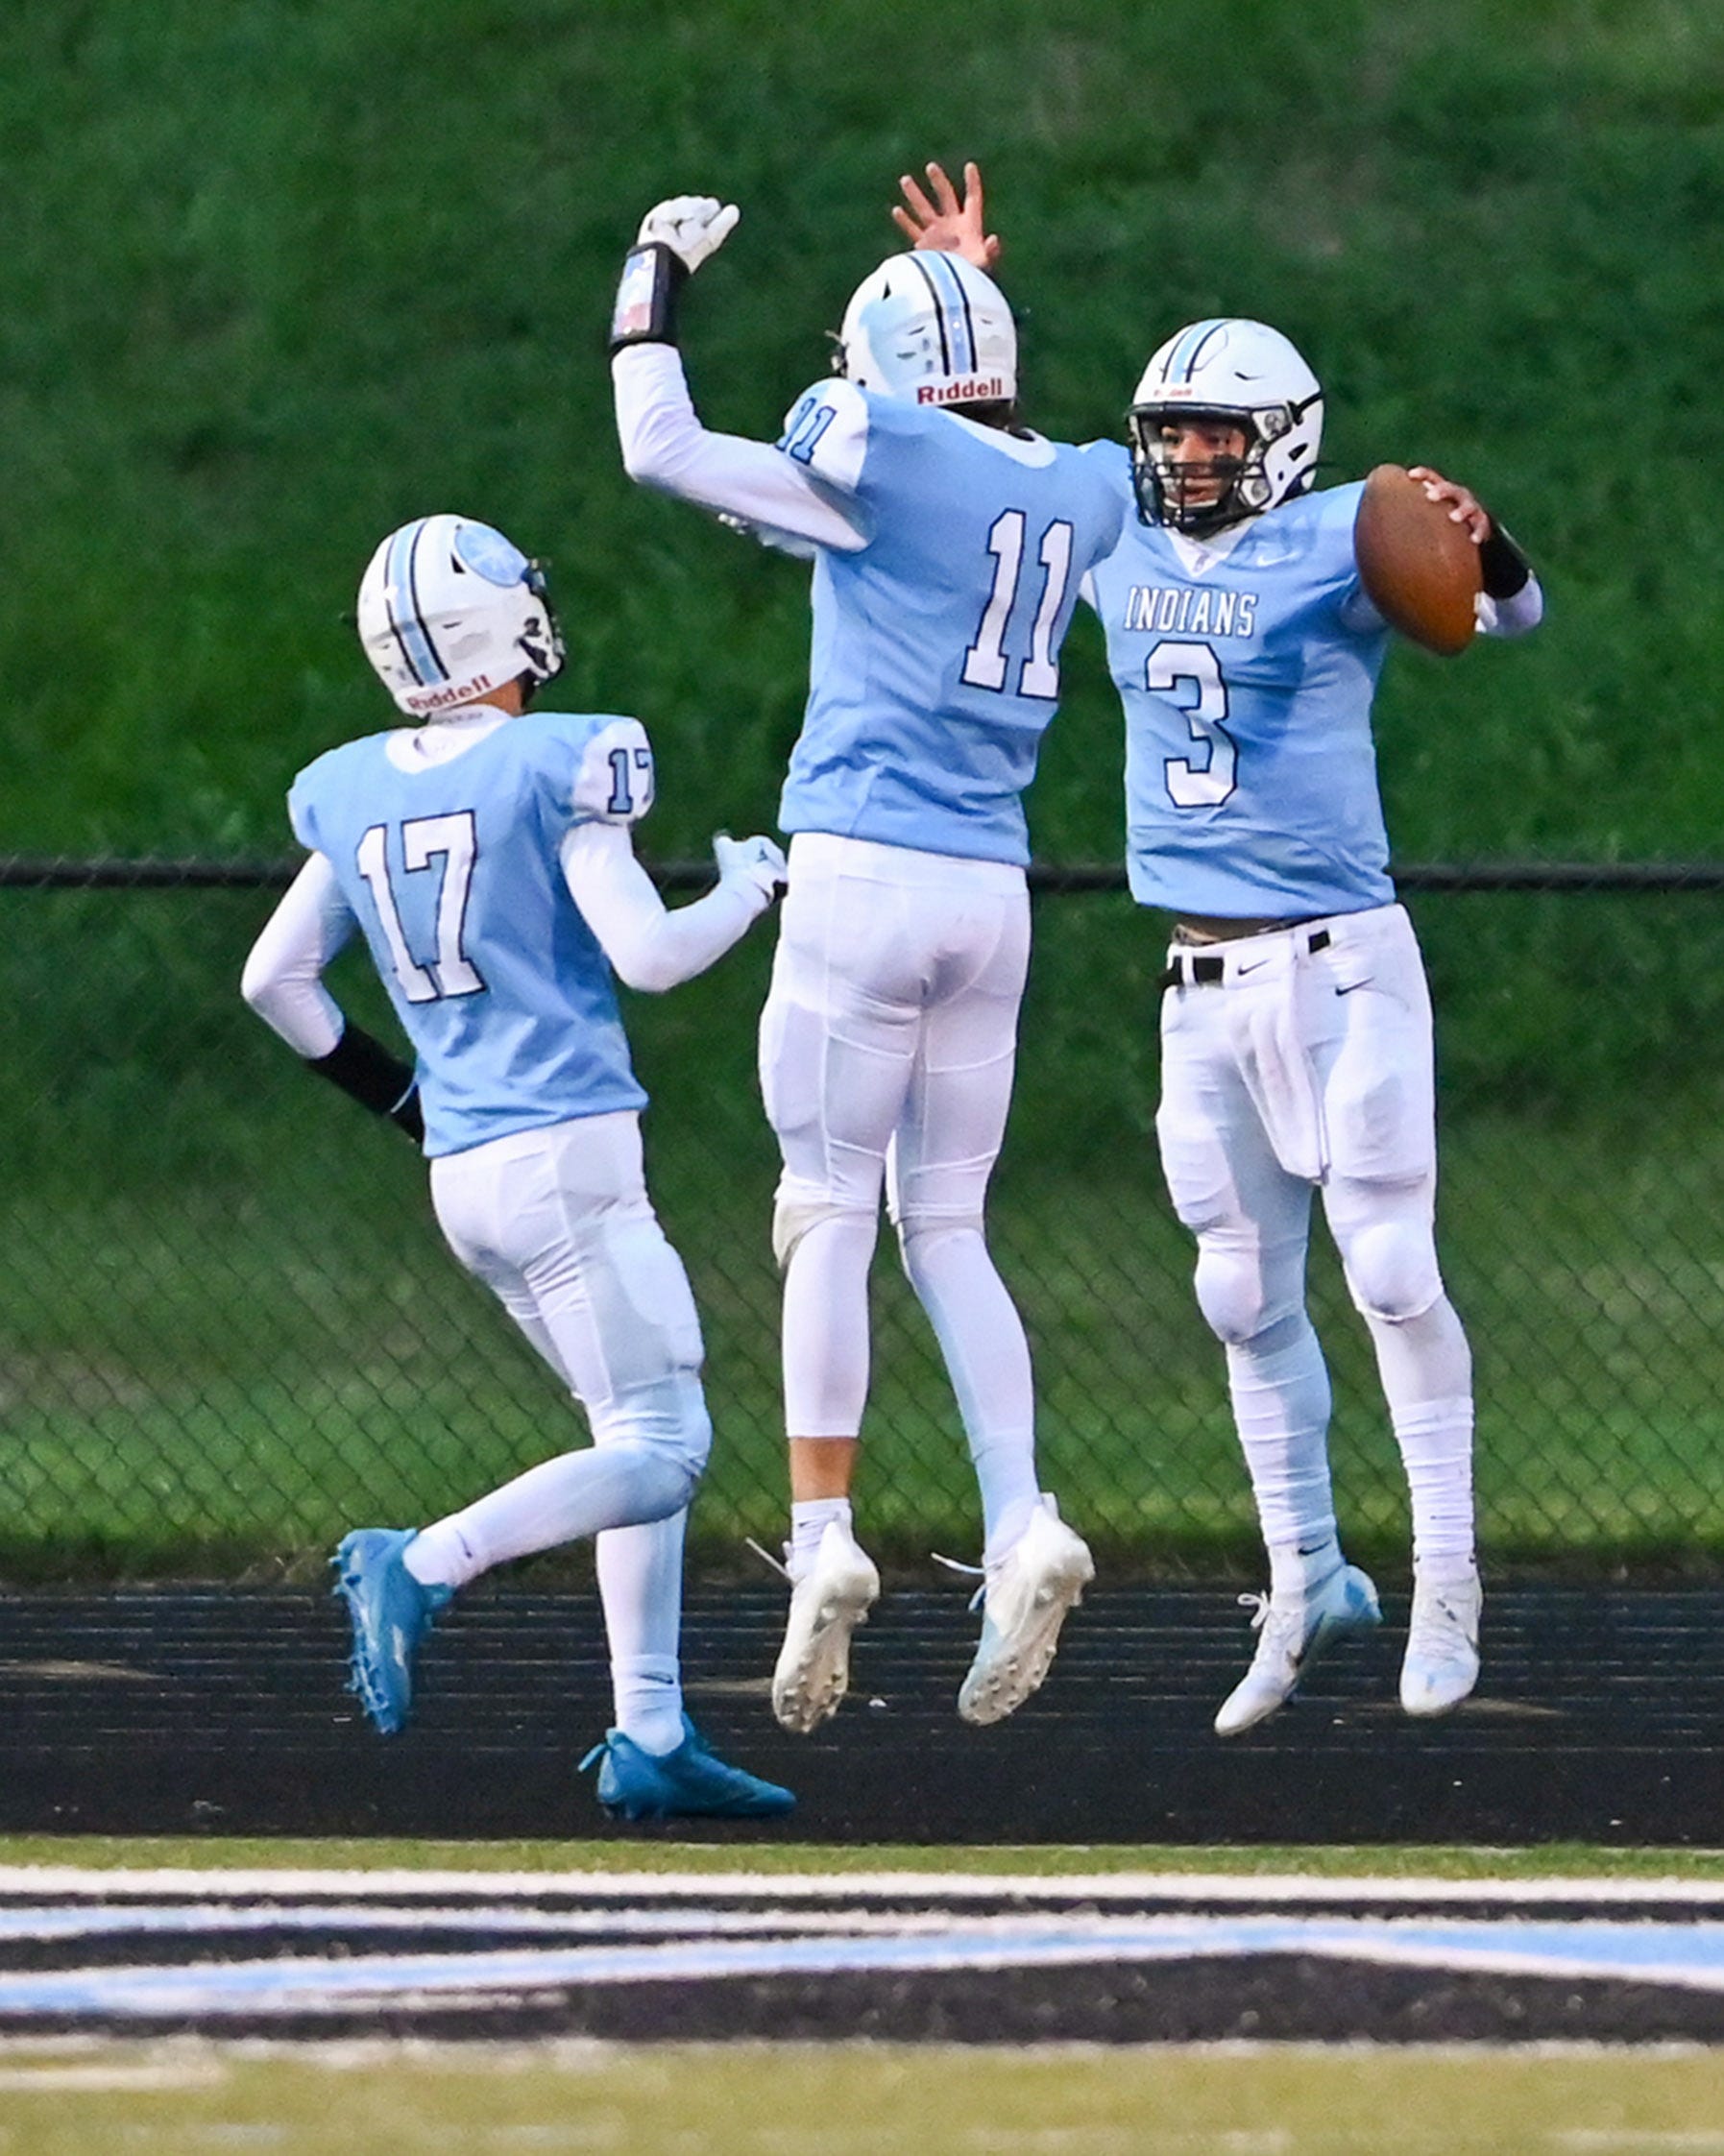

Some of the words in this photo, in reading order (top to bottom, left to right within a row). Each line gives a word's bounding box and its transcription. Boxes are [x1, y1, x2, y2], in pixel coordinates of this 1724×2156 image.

[918, 378, 1003, 404] Riddell
[960, 508, 1074, 699] 11
[1125, 588, 1259, 638] INDIANS
[1146, 640, 1238, 808] 3
[355, 809, 486, 1004] 17
